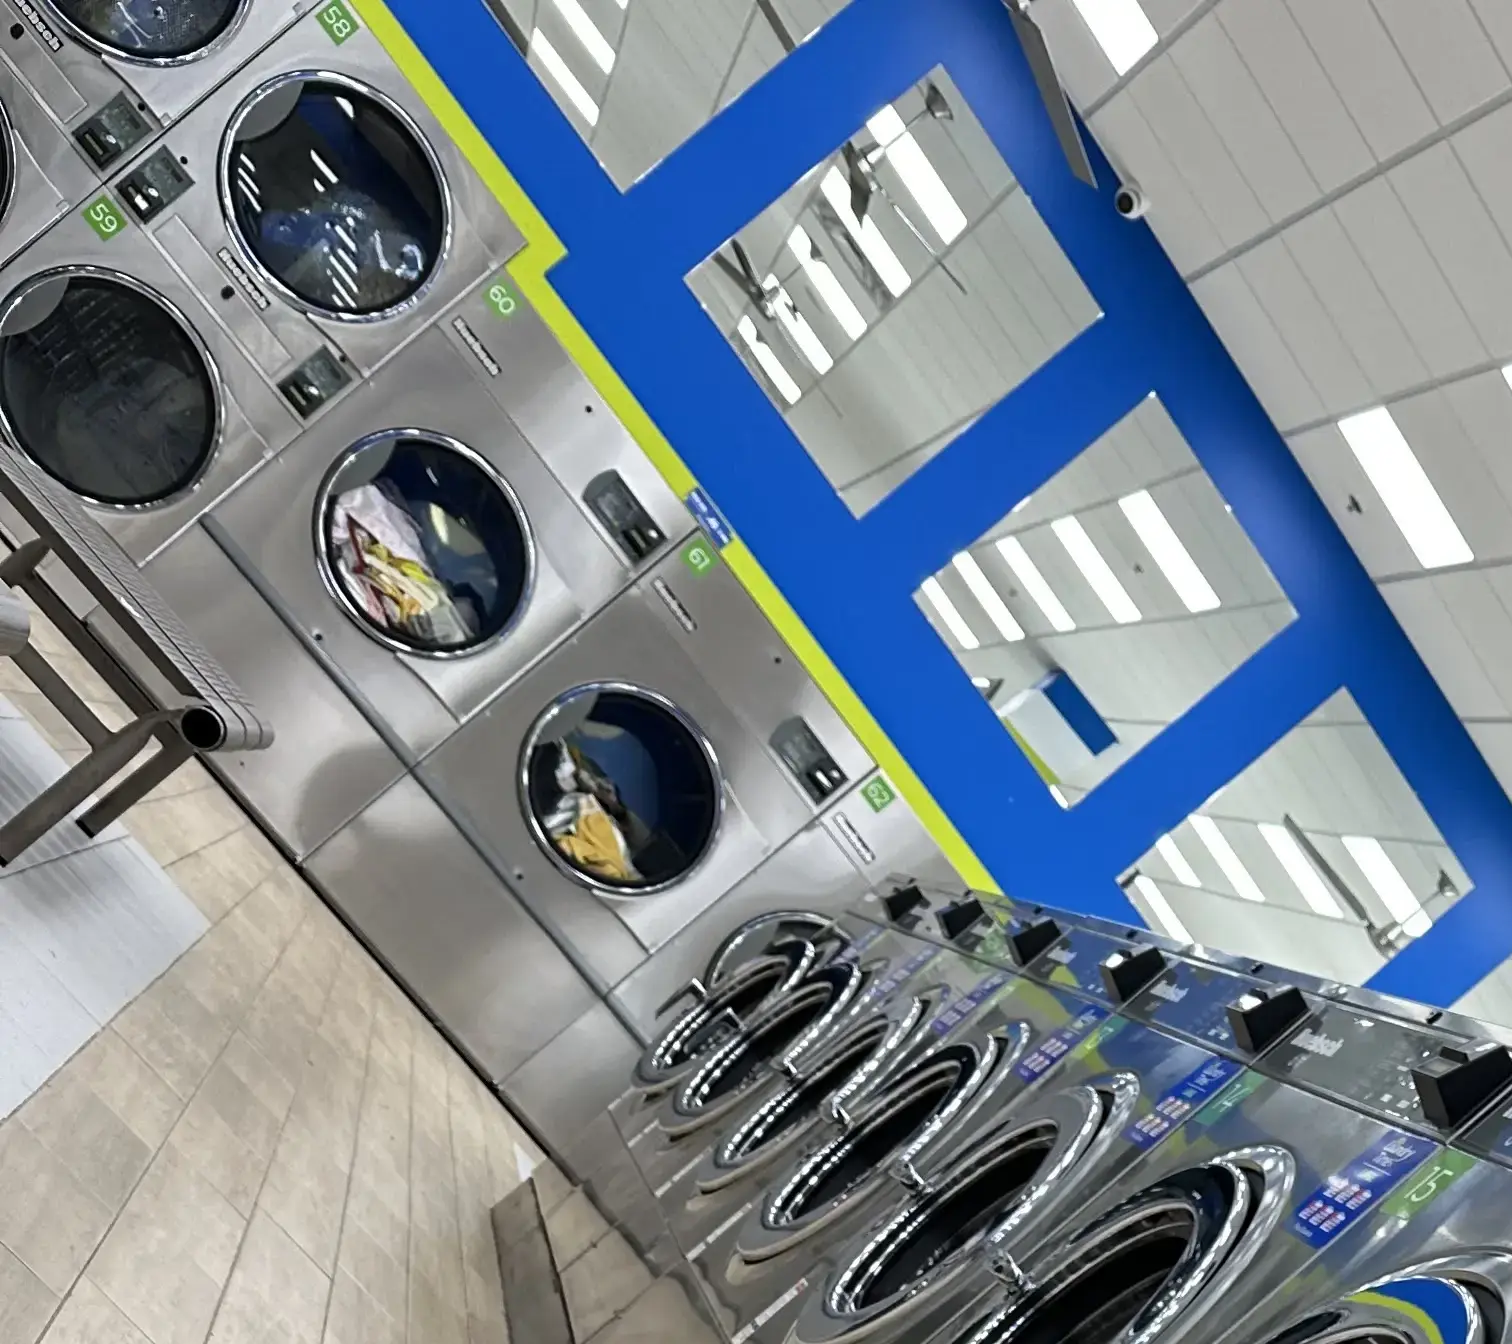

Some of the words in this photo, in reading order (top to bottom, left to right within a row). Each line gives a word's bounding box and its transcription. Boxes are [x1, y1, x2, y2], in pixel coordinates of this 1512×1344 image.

[323, 7, 351, 37] 58
[89, 203, 118, 233] 59
[488, 284, 517, 314] 60
[688, 547, 711, 569] 61
[865, 781, 891, 807] 62
[1212, 1083, 1250, 1112] 14
[1403, 1165, 1455, 1202] 15
